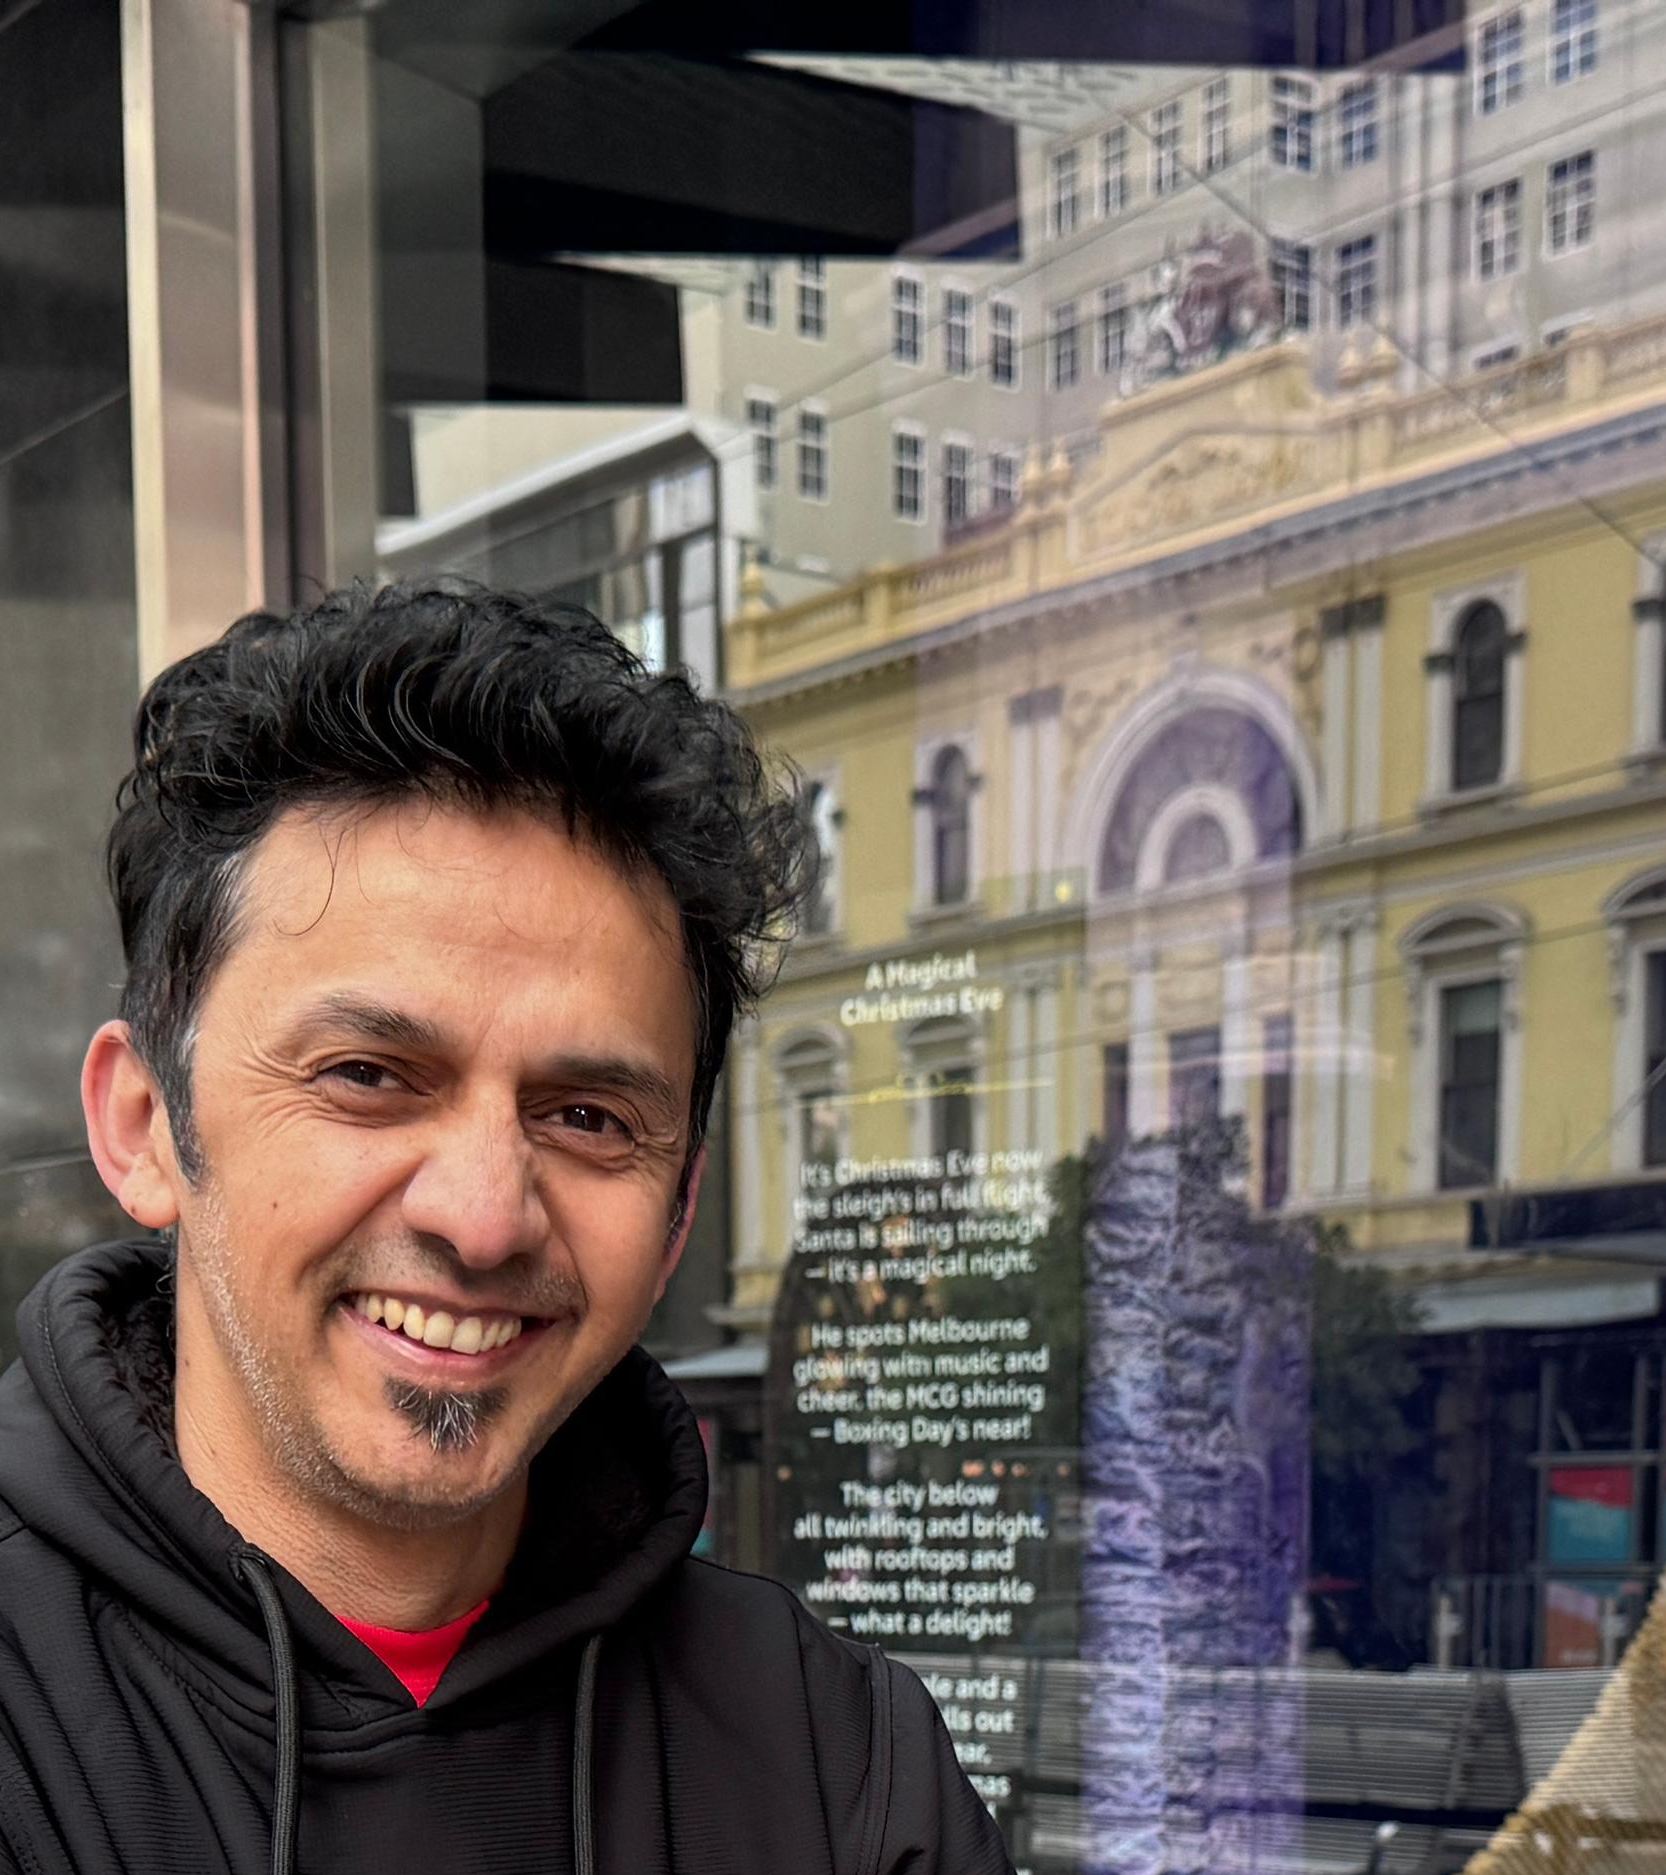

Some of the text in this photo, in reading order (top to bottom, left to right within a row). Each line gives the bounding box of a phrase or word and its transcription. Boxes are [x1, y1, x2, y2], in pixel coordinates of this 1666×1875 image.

[864, 949, 977, 990] A Magical
[840, 986, 1004, 1026] Christmas Eve
[835, 1157, 944, 1185] Christmas
[947, 1149, 989, 1177] Eve
[990, 1150, 1041, 1174] now
[794, 1193, 830, 1218] the
[832, 1187, 913, 1221] sleigh's
[915, 1185, 938, 1212] in
[941, 1181, 982, 1210] full
[794, 1214, 1049, 1252] Santa is sailing through
[862, 1259, 878, 1281] a
[880, 1248, 967, 1284] magical
[812, 1316, 1030, 1352] He spots Melbourne
[794, 1342, 1050, 1387] glowing with music and
[866, 1384, 904, 1411] the
[906, 1382, 959, 1410] MCG
[961, 1378, 1046, 1412] shining
[834, 1416, 909, 1449] Boxing
[912, 1414, 970, 1448] Day's
[972, 1412, 1031, 1441] near!
[840, 1478, 1000, 1512] The city below
[793, 1511, 821, 1540] all
[824, 1511, 923, 1544] twinkling
[926, 1510, 970, 1539] and
[824, 1543, 1015, 1575] with rooftops and
[805, 1574, 1035, 1608] windows that sparkle
[851, 1606, 904, 1634] what
[907, 1613, 923, 1635] a
[925, 1607, 1013, 1640] delight!
[955, 1673, 999, 1701] and
[1002, 1679, 1018, 1701] a
[974, 1709, 1015, 1733] out
